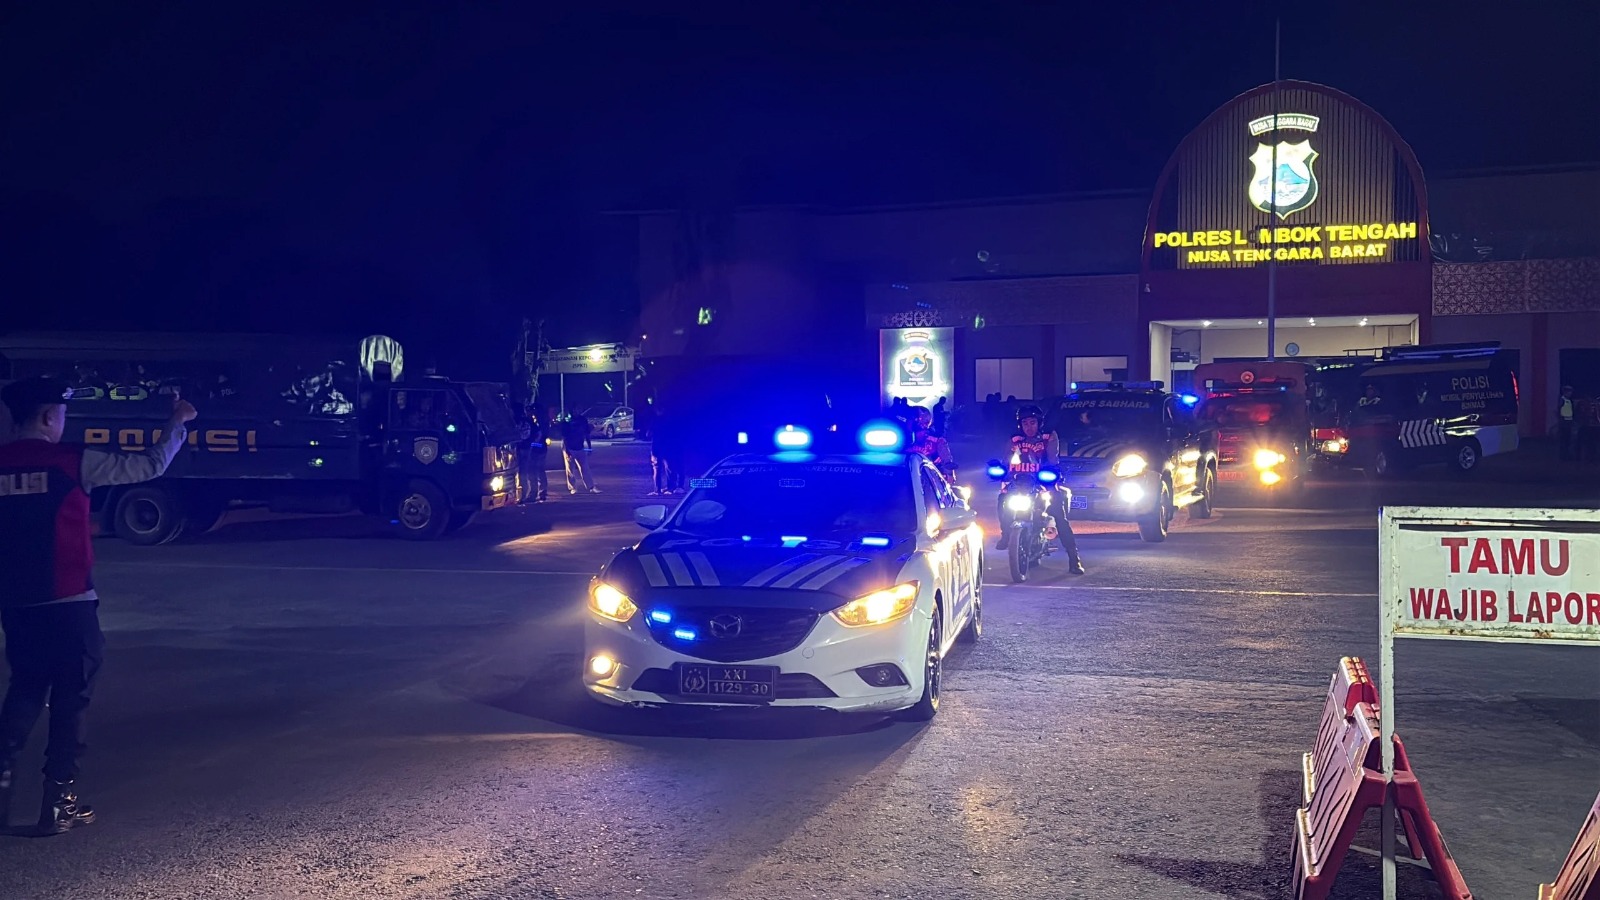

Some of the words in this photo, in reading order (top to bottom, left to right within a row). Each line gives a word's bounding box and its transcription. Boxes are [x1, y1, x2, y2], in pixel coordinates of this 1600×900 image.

[1154, 230, 1232, 247] POLRES
[1325, 222, 1417, 241] TENGAH
[1188, 250, 1230, 263] NUSA
[1330, 243, 1387, 259] BARAT
[1452, 375, 1490, 390] POLISI
[1060, 400, 1096, 409] KORPS
[1098, 400, 1150, 409] SABHARA
[1009, 462, 1040, 473] POLISI
[1441, 537, 1570, 576] TAMU
[1410, 587, 1498, 622] WAJIB
[1508, 590, 1600, 625] LAPOR
[724, 669, 747, 680] XXI
